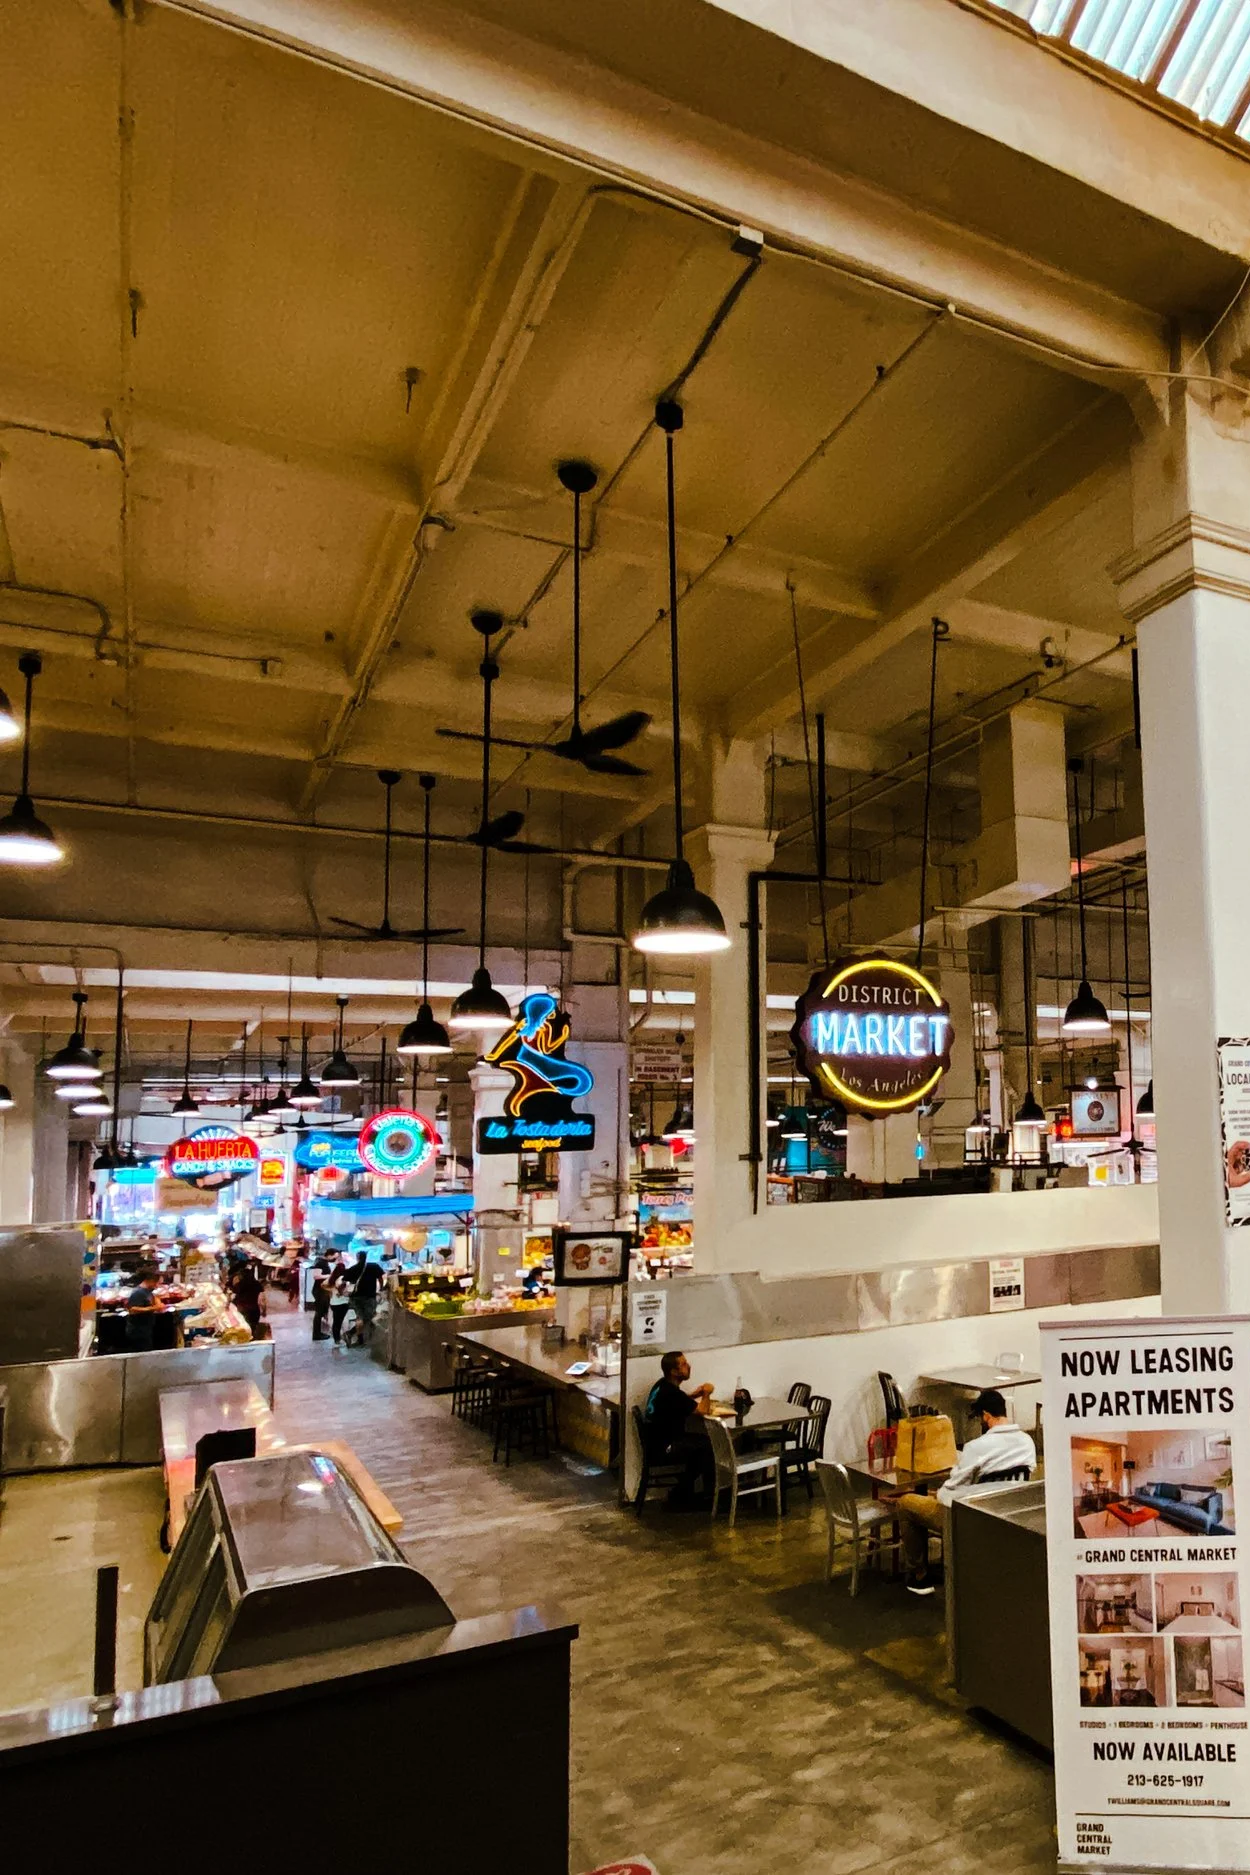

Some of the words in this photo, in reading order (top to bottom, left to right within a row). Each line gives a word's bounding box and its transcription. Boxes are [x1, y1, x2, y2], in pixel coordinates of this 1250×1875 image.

[838, 984, 923, 1006] DISTRICT
[815, 1011, 949, 1057] MARKET
[841, 1067, 862, 1089] Los
[867, 1070, 923, 1094] Angeles
[485, 1121, 508, 1138] La
[512, 1119, 592, 1137] Tostaderia
[175, 1143, 195, 1160] LA
[198, 1141, 252, 1160] HUERTA
[1061, 1350, 1120, 1377] NOW
[1131, 1346, 1234, 1374] LEASING
[1065, 1387, 1234, 1418] APARTMENTS
[1085, 1550, 1126, 1563] GRAND
[1130, 1548, 1183, 1562] CENTRAL
[1187, 1547, 1237, 1561] MARKET
[1079, 1721, 1106, 1729] STUDIOS
[1118, 1721, 1154, 1729] BEDROOMS
[1167, 1721, 1203, 1729] BEDROOMS
[1210, 1721, 1248, 1730] PENTHOUSE
[1093, 1742, 1135, 1761] NOW
[1142, 1742, 1236, 1762] AVAILABLE
[1127, 1774, 1204, 1787] 213-625-1917
[1076, 1823, 1104, 1833] GRAND
[1076, 1834, 1112, 1844] CENTRAL
[1077, 1845, 1110, 1855] MARKET
